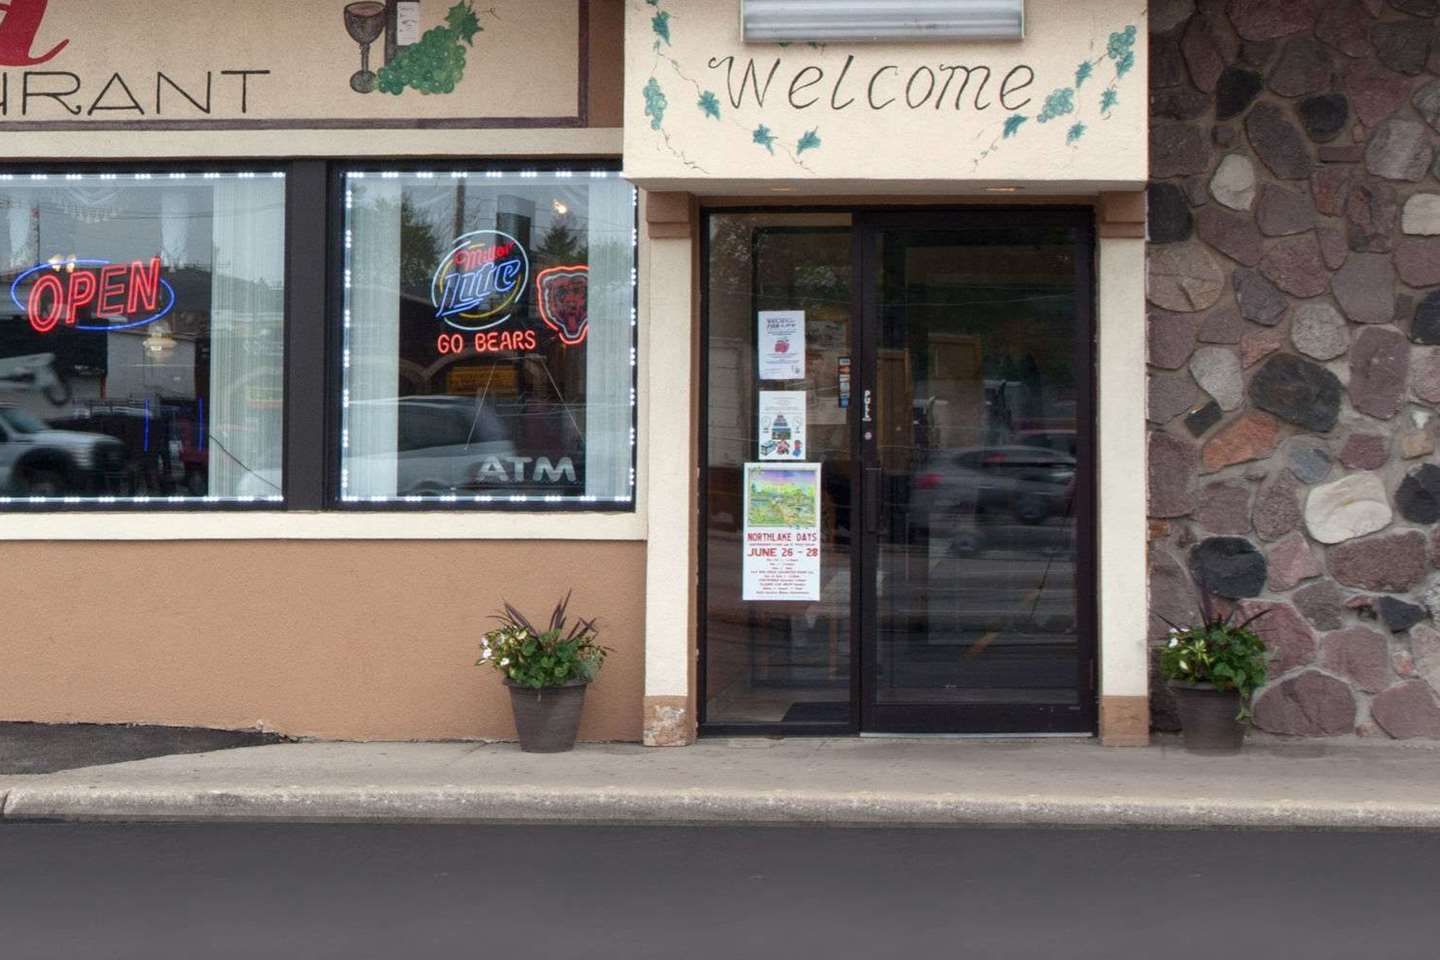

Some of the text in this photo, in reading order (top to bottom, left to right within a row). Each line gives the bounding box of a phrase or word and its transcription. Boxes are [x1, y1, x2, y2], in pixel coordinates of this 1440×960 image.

[708, 54, 1034, 110] Welcome
[28, 255, 161, 332] OPEN
[437, 330, 536, 354] GO BEARS
[477, 456, 577, 482] ATM
[747, 532, 817, 542] NORTHLAKE DAYS
[747, 547, 777, 557] JUNE
[781, 547, 794, 557] 26
[806, 547, 818, 557] 28
